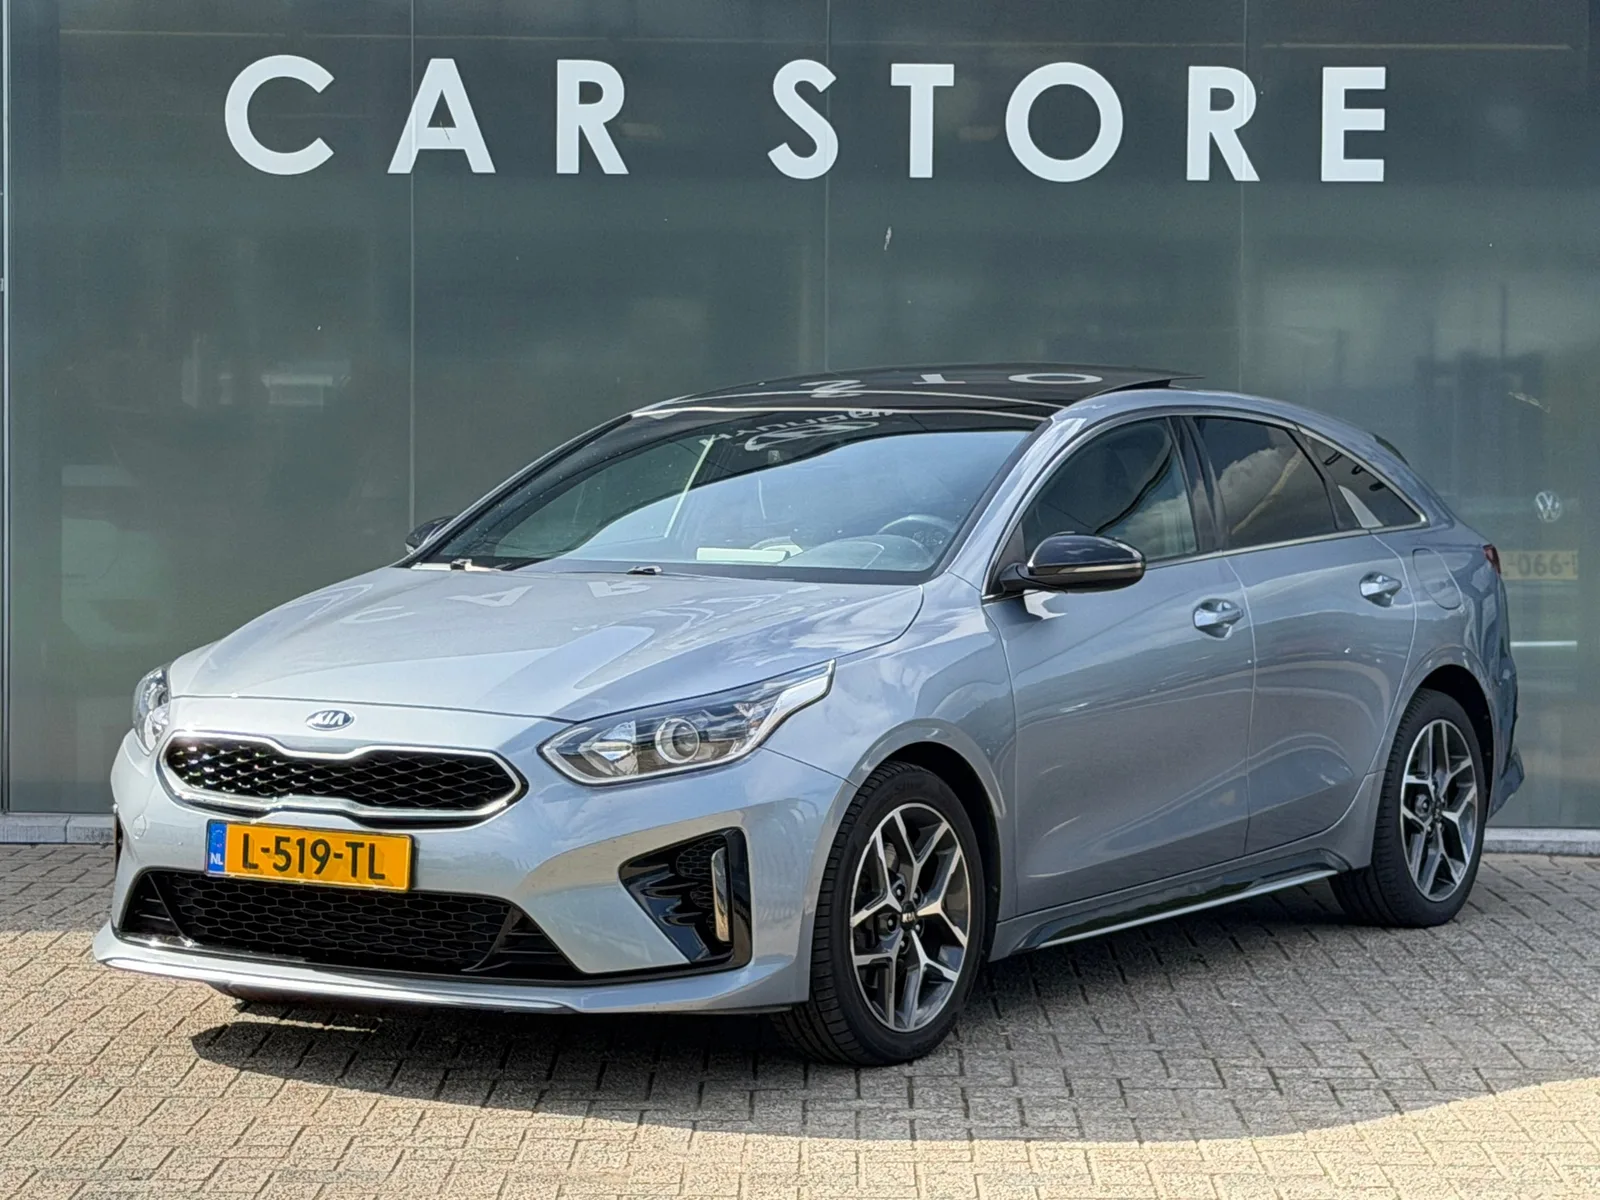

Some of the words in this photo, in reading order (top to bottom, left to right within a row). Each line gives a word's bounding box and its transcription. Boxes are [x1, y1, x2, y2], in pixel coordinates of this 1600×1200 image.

[225, 55, 628, 175] CAR
[768, 59, 1386, 182] STORE
[307, 711, 346, 726] KIA
[210, 852, 224, 866] NL
[242, 833, 386, 880] L-519-TL
